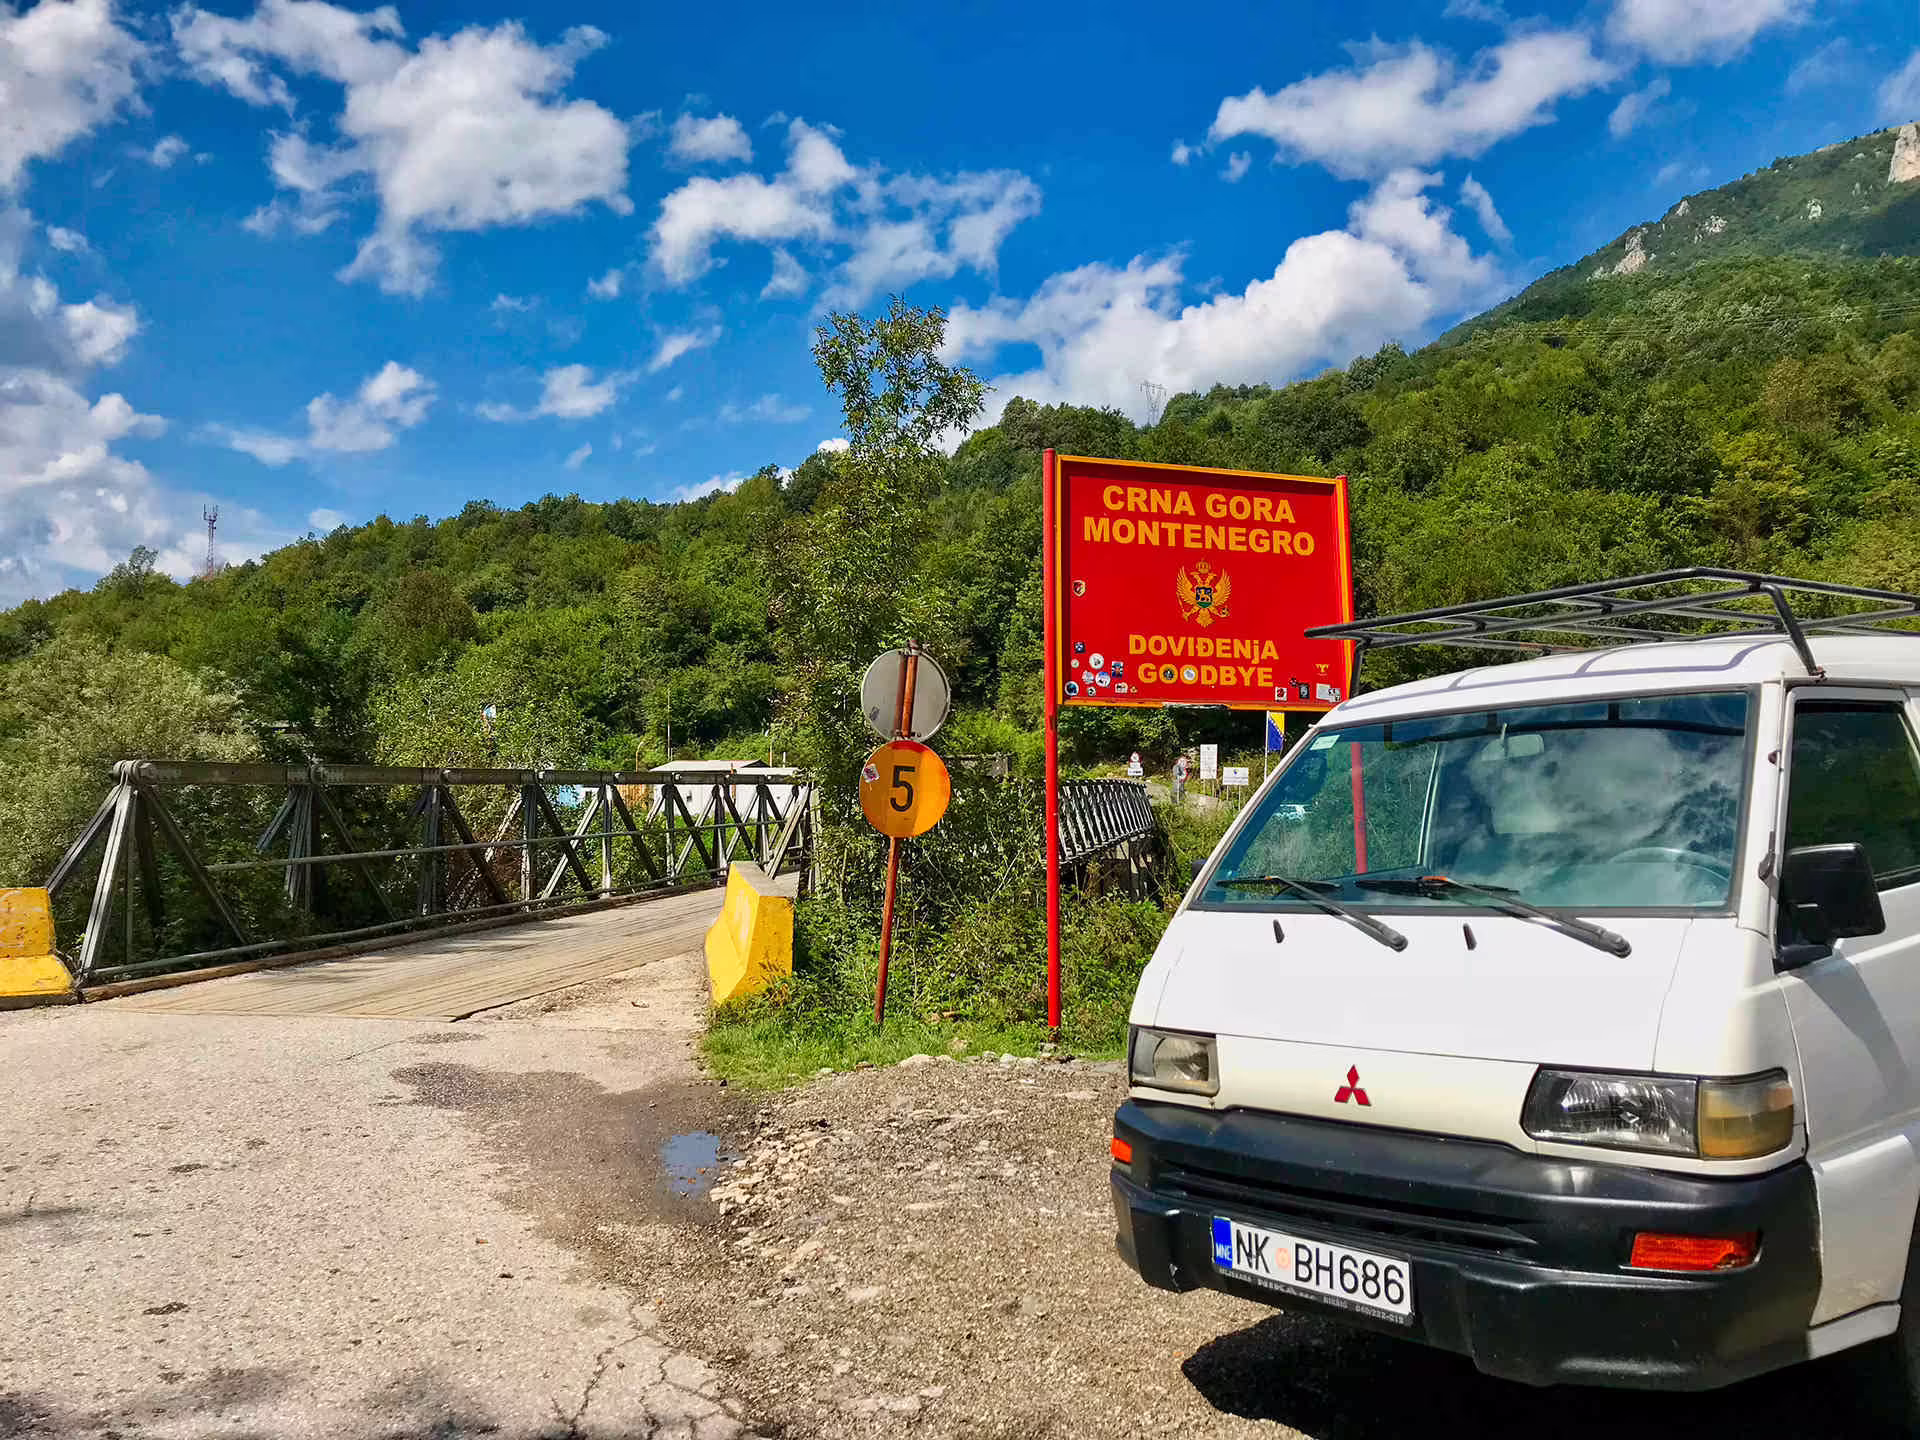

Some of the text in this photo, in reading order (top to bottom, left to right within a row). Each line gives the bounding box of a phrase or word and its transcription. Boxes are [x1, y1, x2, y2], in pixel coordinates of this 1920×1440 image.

[1103, 485, 1296, 523] CRNA GORA
[1084, 516, 1315, 556] MONTENEGRO
[1138, 663, 1274, 688] GOODBYE
[889, 765, 916, 812] 5
[1215, 1242, 1233, 1261] MNE
[1236, 1229, 1405, 1305] NK BH686
